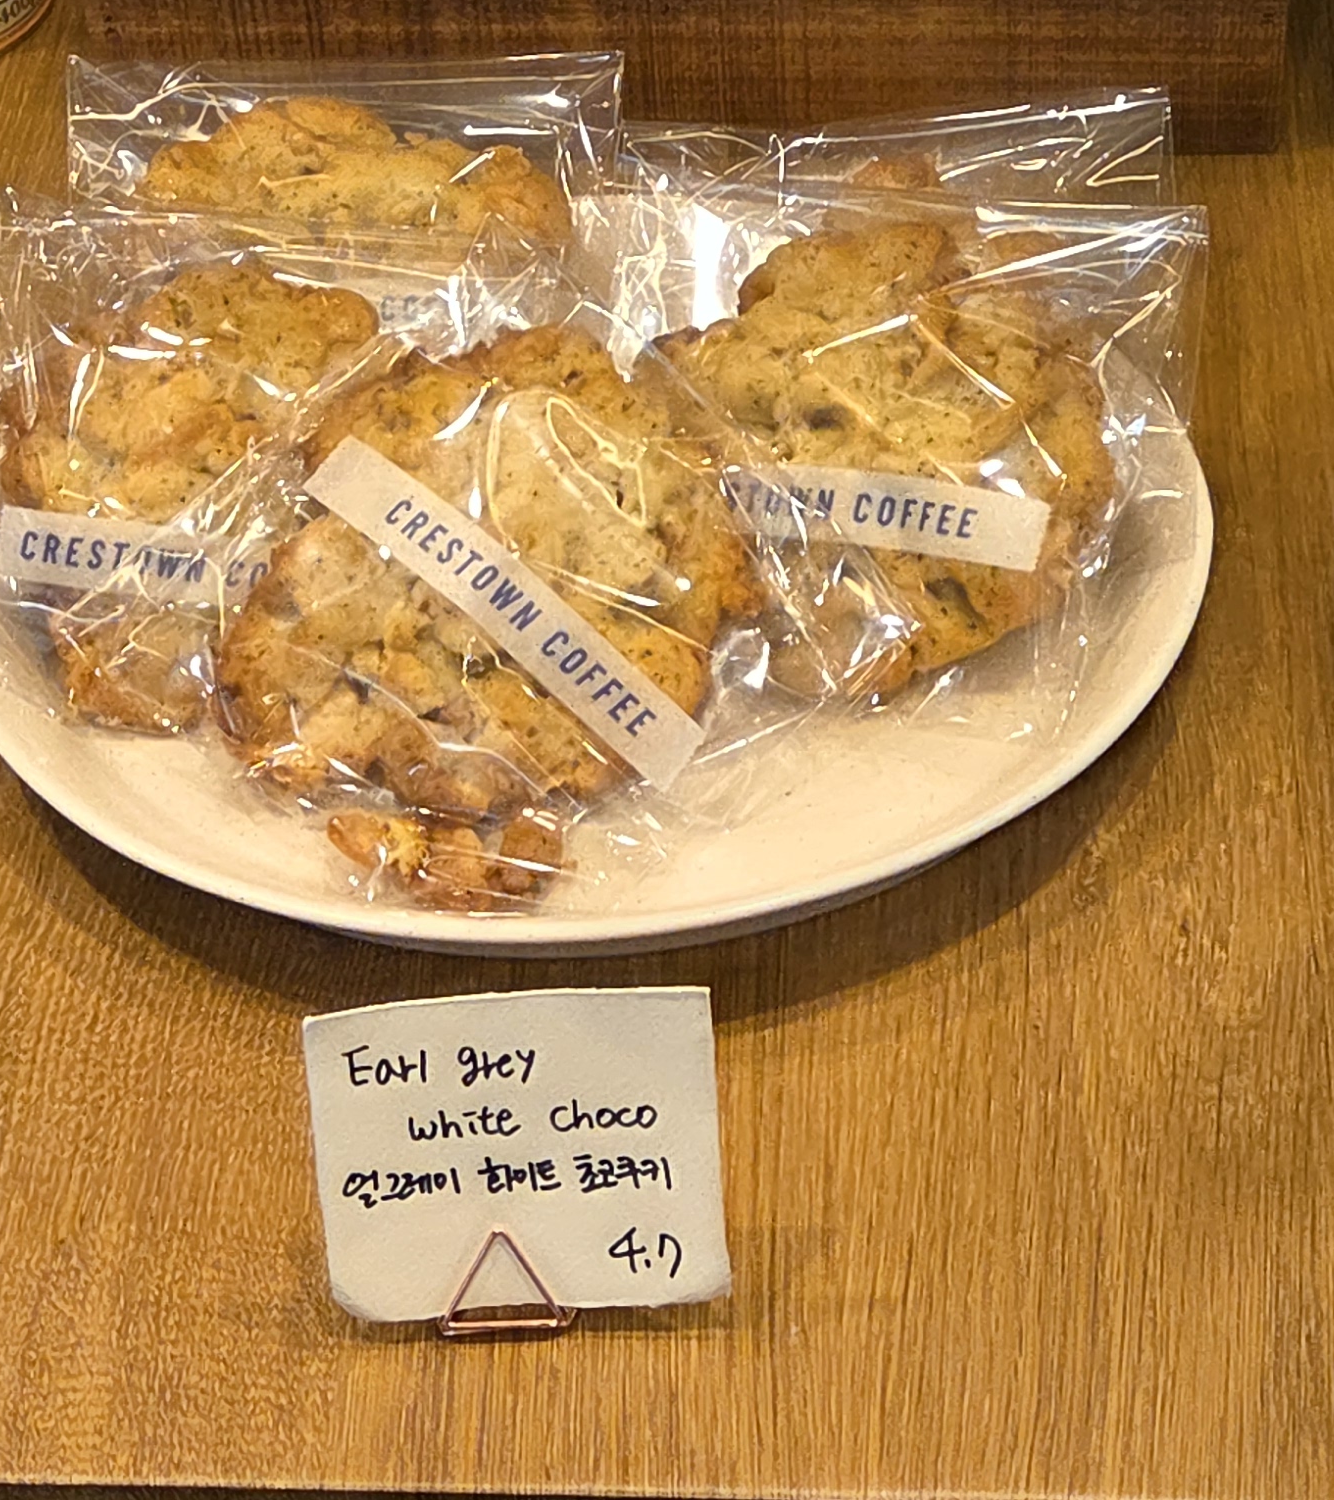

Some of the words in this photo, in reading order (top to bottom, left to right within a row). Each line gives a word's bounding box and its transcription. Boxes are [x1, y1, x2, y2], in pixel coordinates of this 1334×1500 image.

[853, 492, 979, 538] COFFEE
[20, 531, 207, 584] CRESTOWN
[385, 499, 542, 632] CRESTOWN
[541, 631, 657, 737] COFFEE
[341, 1046, 427, 1087] Earl
[342, 1167, 461, 1209] 얼그레이
[608, 1227, 682, 1279] 4.7
